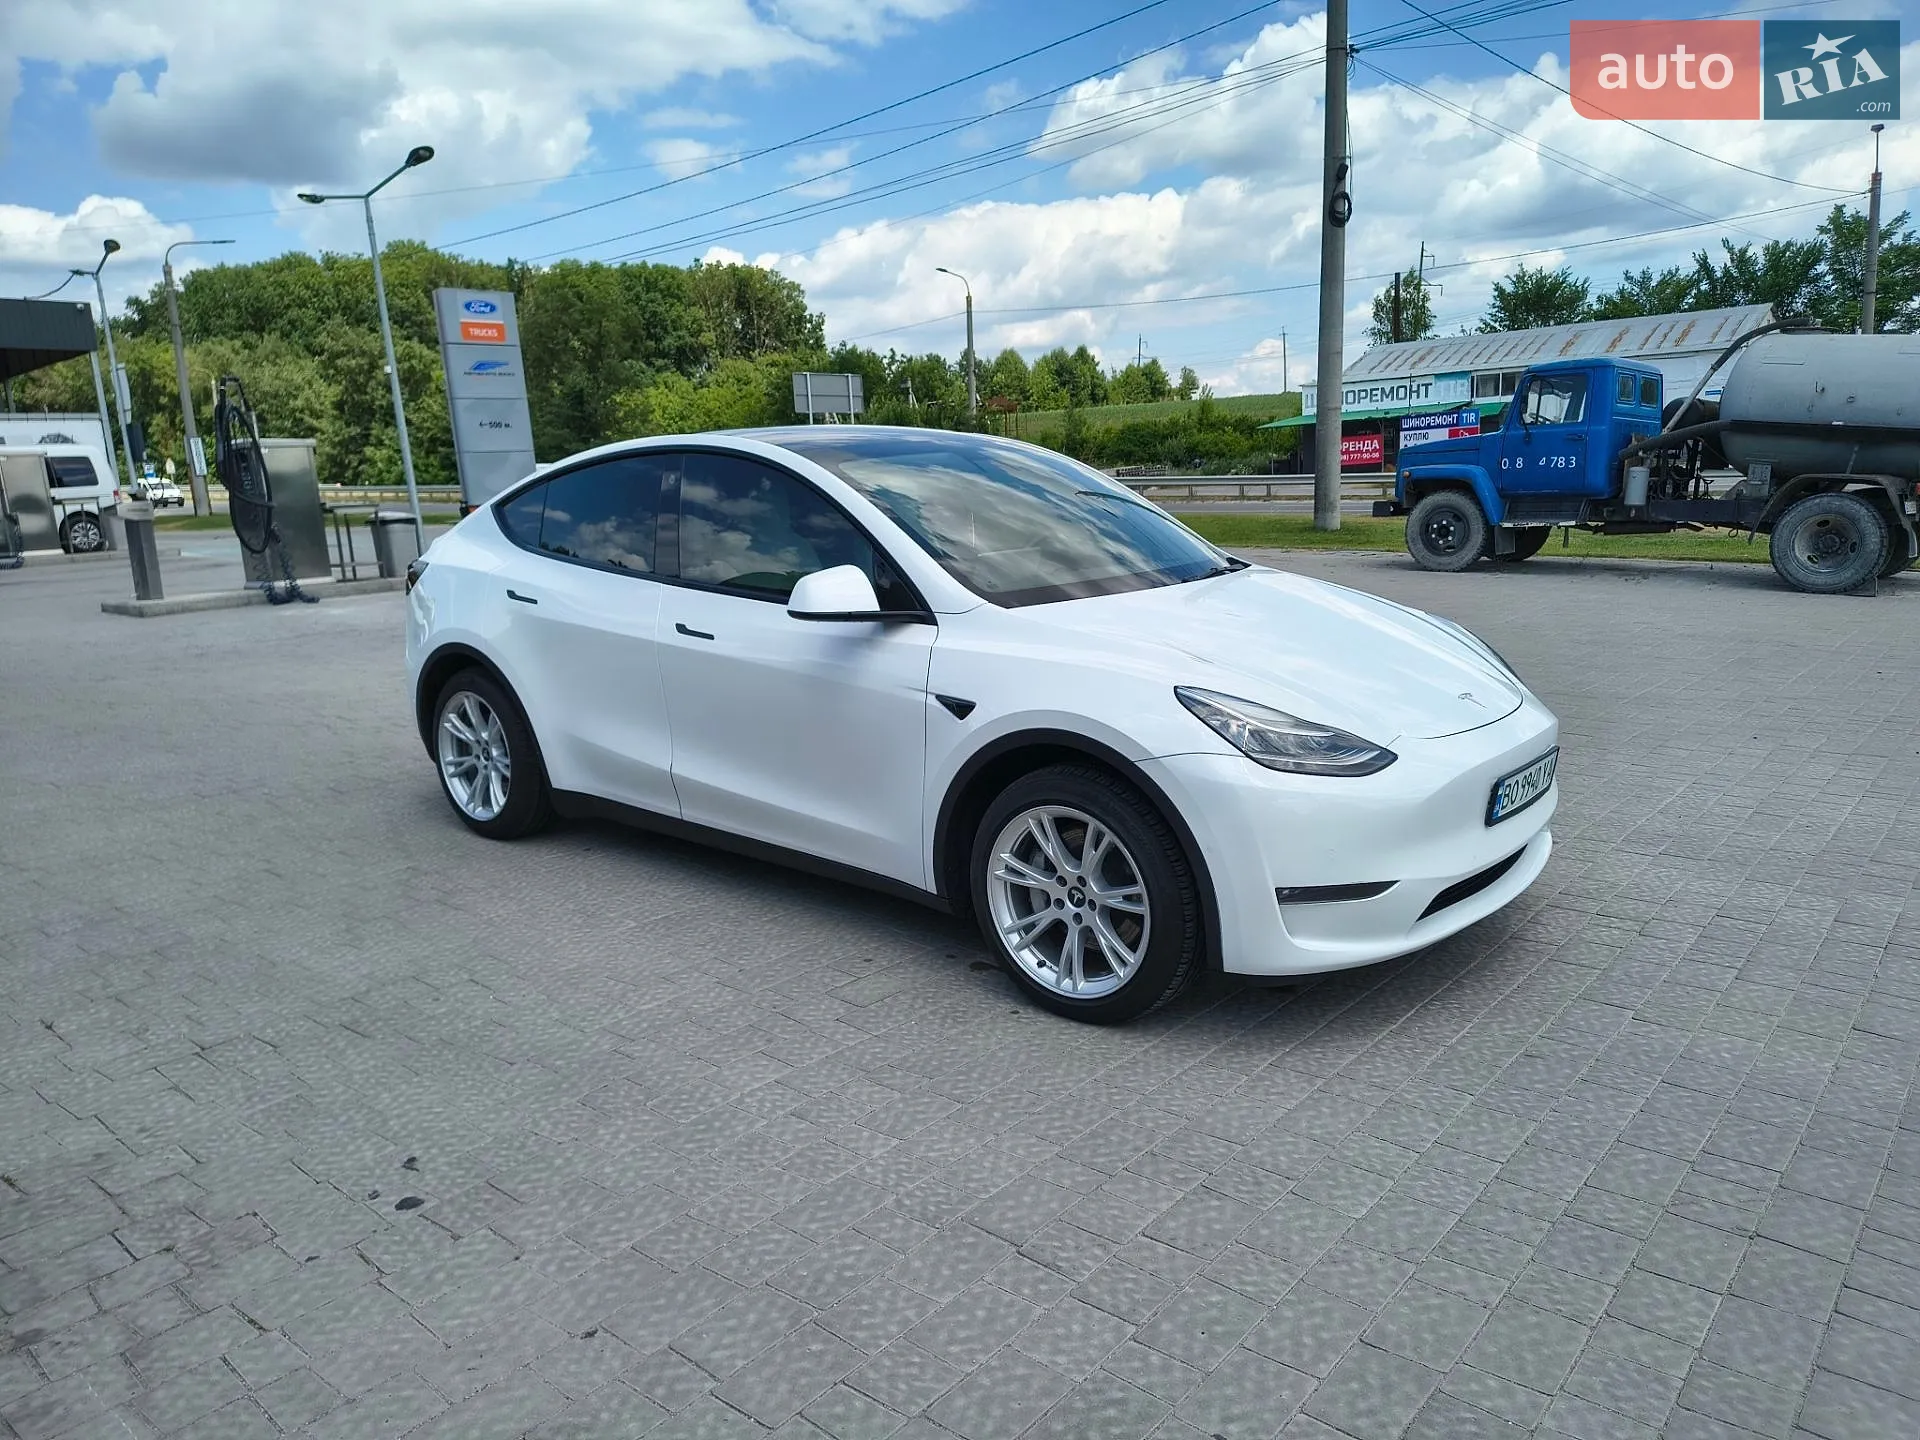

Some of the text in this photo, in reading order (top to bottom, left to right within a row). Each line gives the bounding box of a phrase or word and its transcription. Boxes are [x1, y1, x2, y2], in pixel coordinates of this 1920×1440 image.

[468, 327, 499, 338] TRUCKS
[1402, 412, 1476, 429] ШИНОРЕМОНТ TIR
[1403, 431, 1430, 442] КУПЛЮ
[1340, 439, 1380, 452] РЕНДА
[1500, 779, 1520, 811] BO
